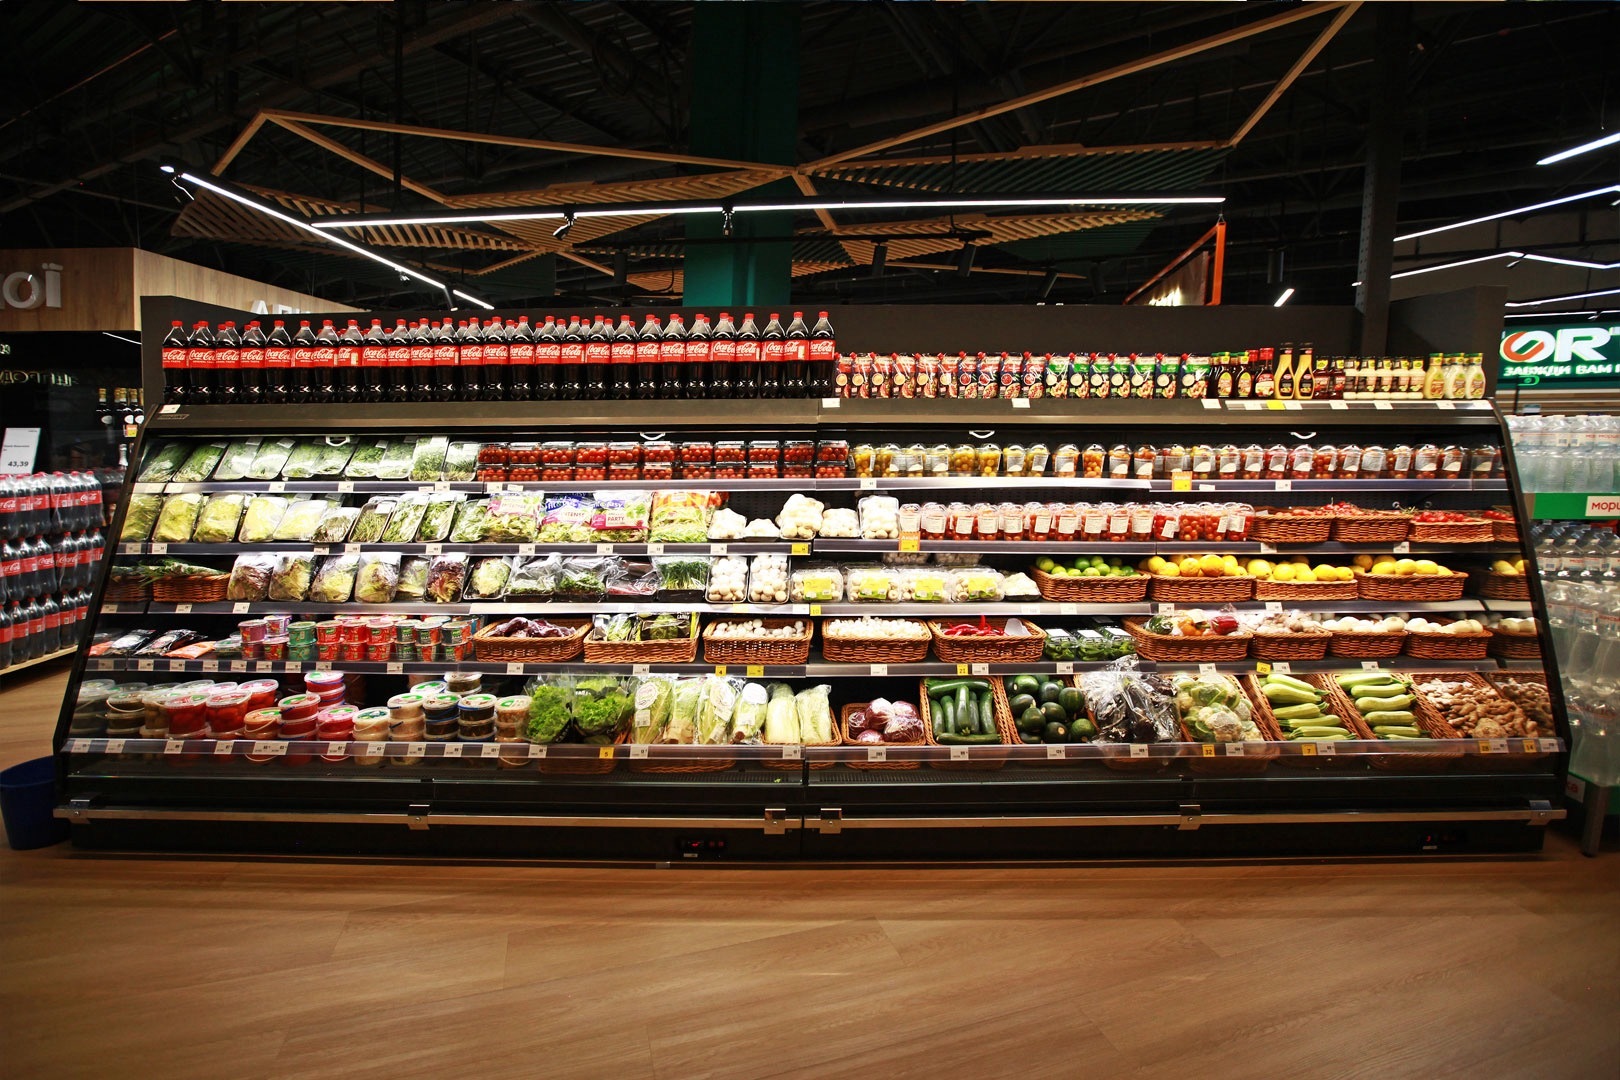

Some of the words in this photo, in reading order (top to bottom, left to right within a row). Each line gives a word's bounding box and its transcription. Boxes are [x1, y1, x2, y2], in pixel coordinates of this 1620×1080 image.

[0, 263, 64, 309] ої
[1500, 326, 1620, 363] OR
[1576, 364, 1612, 375] ВАМ
